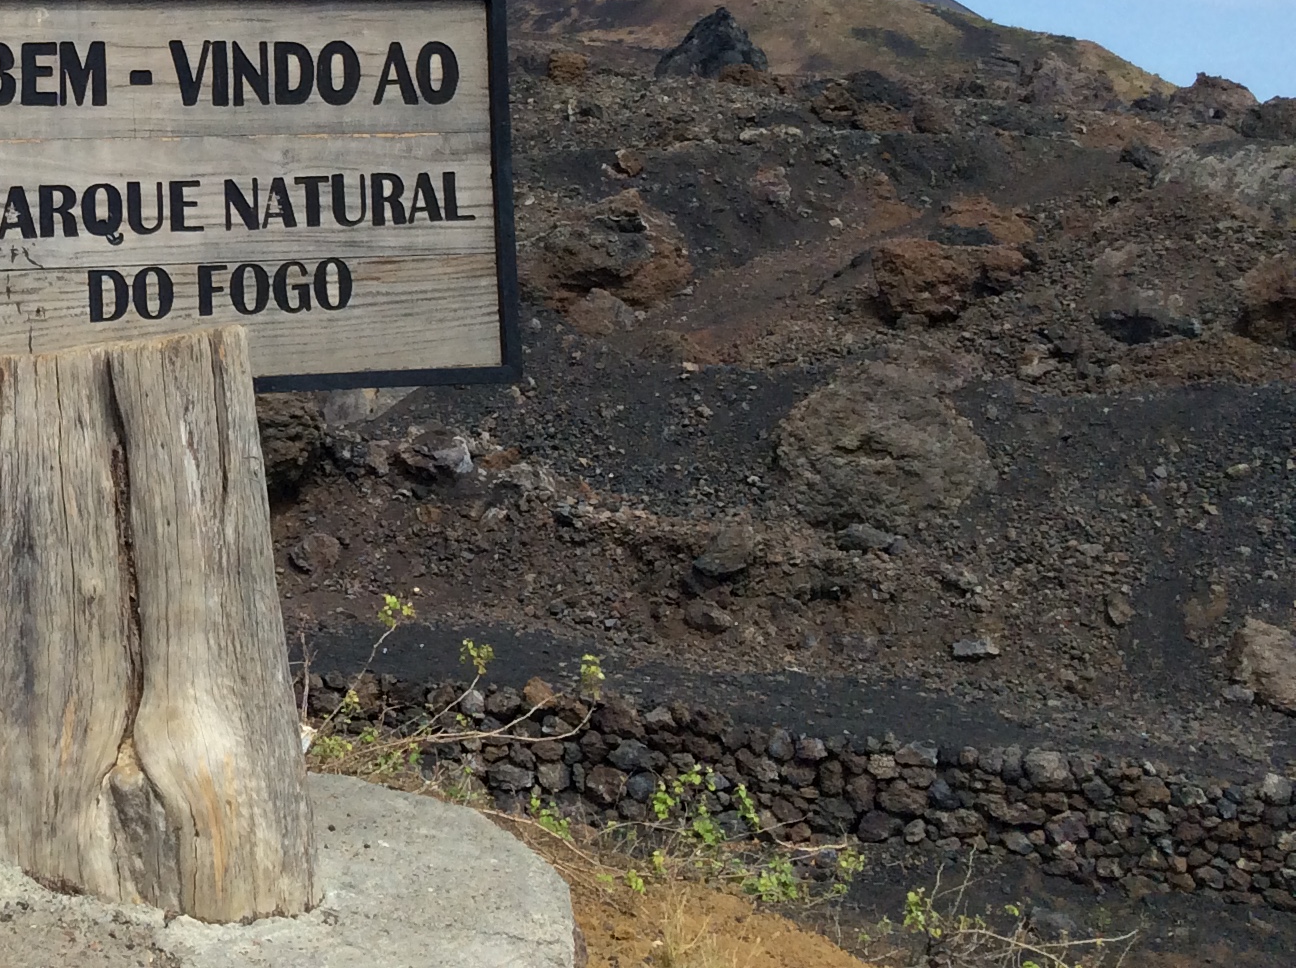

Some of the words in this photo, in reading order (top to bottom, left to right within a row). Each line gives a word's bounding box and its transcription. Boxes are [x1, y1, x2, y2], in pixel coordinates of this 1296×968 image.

[169, 40, 361, 106] VINDO
[373, 40, 459, 106] AO
[223, 171, 477, 231] NATURAL
[87, 267, 174, 323] DO
[196, 257, 353, 317] FOGO
